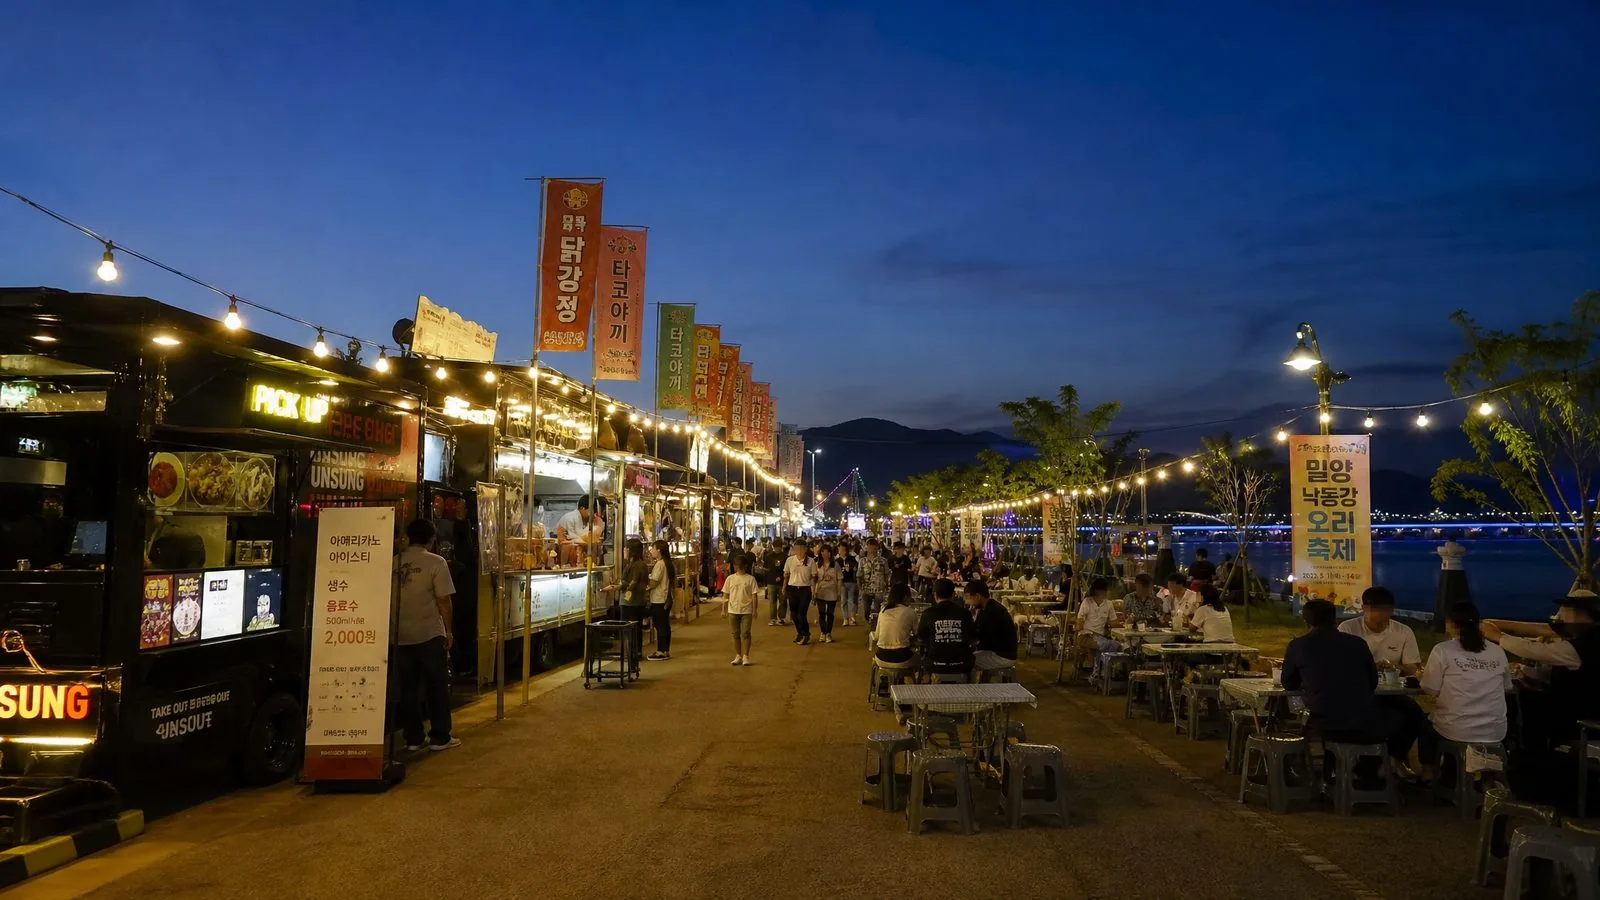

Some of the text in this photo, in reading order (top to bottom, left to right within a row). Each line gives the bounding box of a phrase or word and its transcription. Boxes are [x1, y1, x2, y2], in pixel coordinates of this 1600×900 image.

[557, 236, 585, 323] 닭강정
[609, 259, 632, 344] 타코야끼
[251, 384, 330, 424] PICK UP
[310, 465, 365, 491] UNSUNG
[1305, 459, 1353, 483] 밀양
[1302, 487, 1359, 507] 낙동강
[1307, 510, 1355, 534] 오리
[330, 535, 381, 547] 아메리카노
[1307, 536, 1356, 562] 축제
[329, 551, 371, 563] 아이스티
[327, 580, 349, 592] 생수
[326, 600, 359, 613] 음료수
[324, 630, 376, 647] 2,000원
[0, 684, 88, 720] SUNG
[150, 705, 172, 719] TAKE
